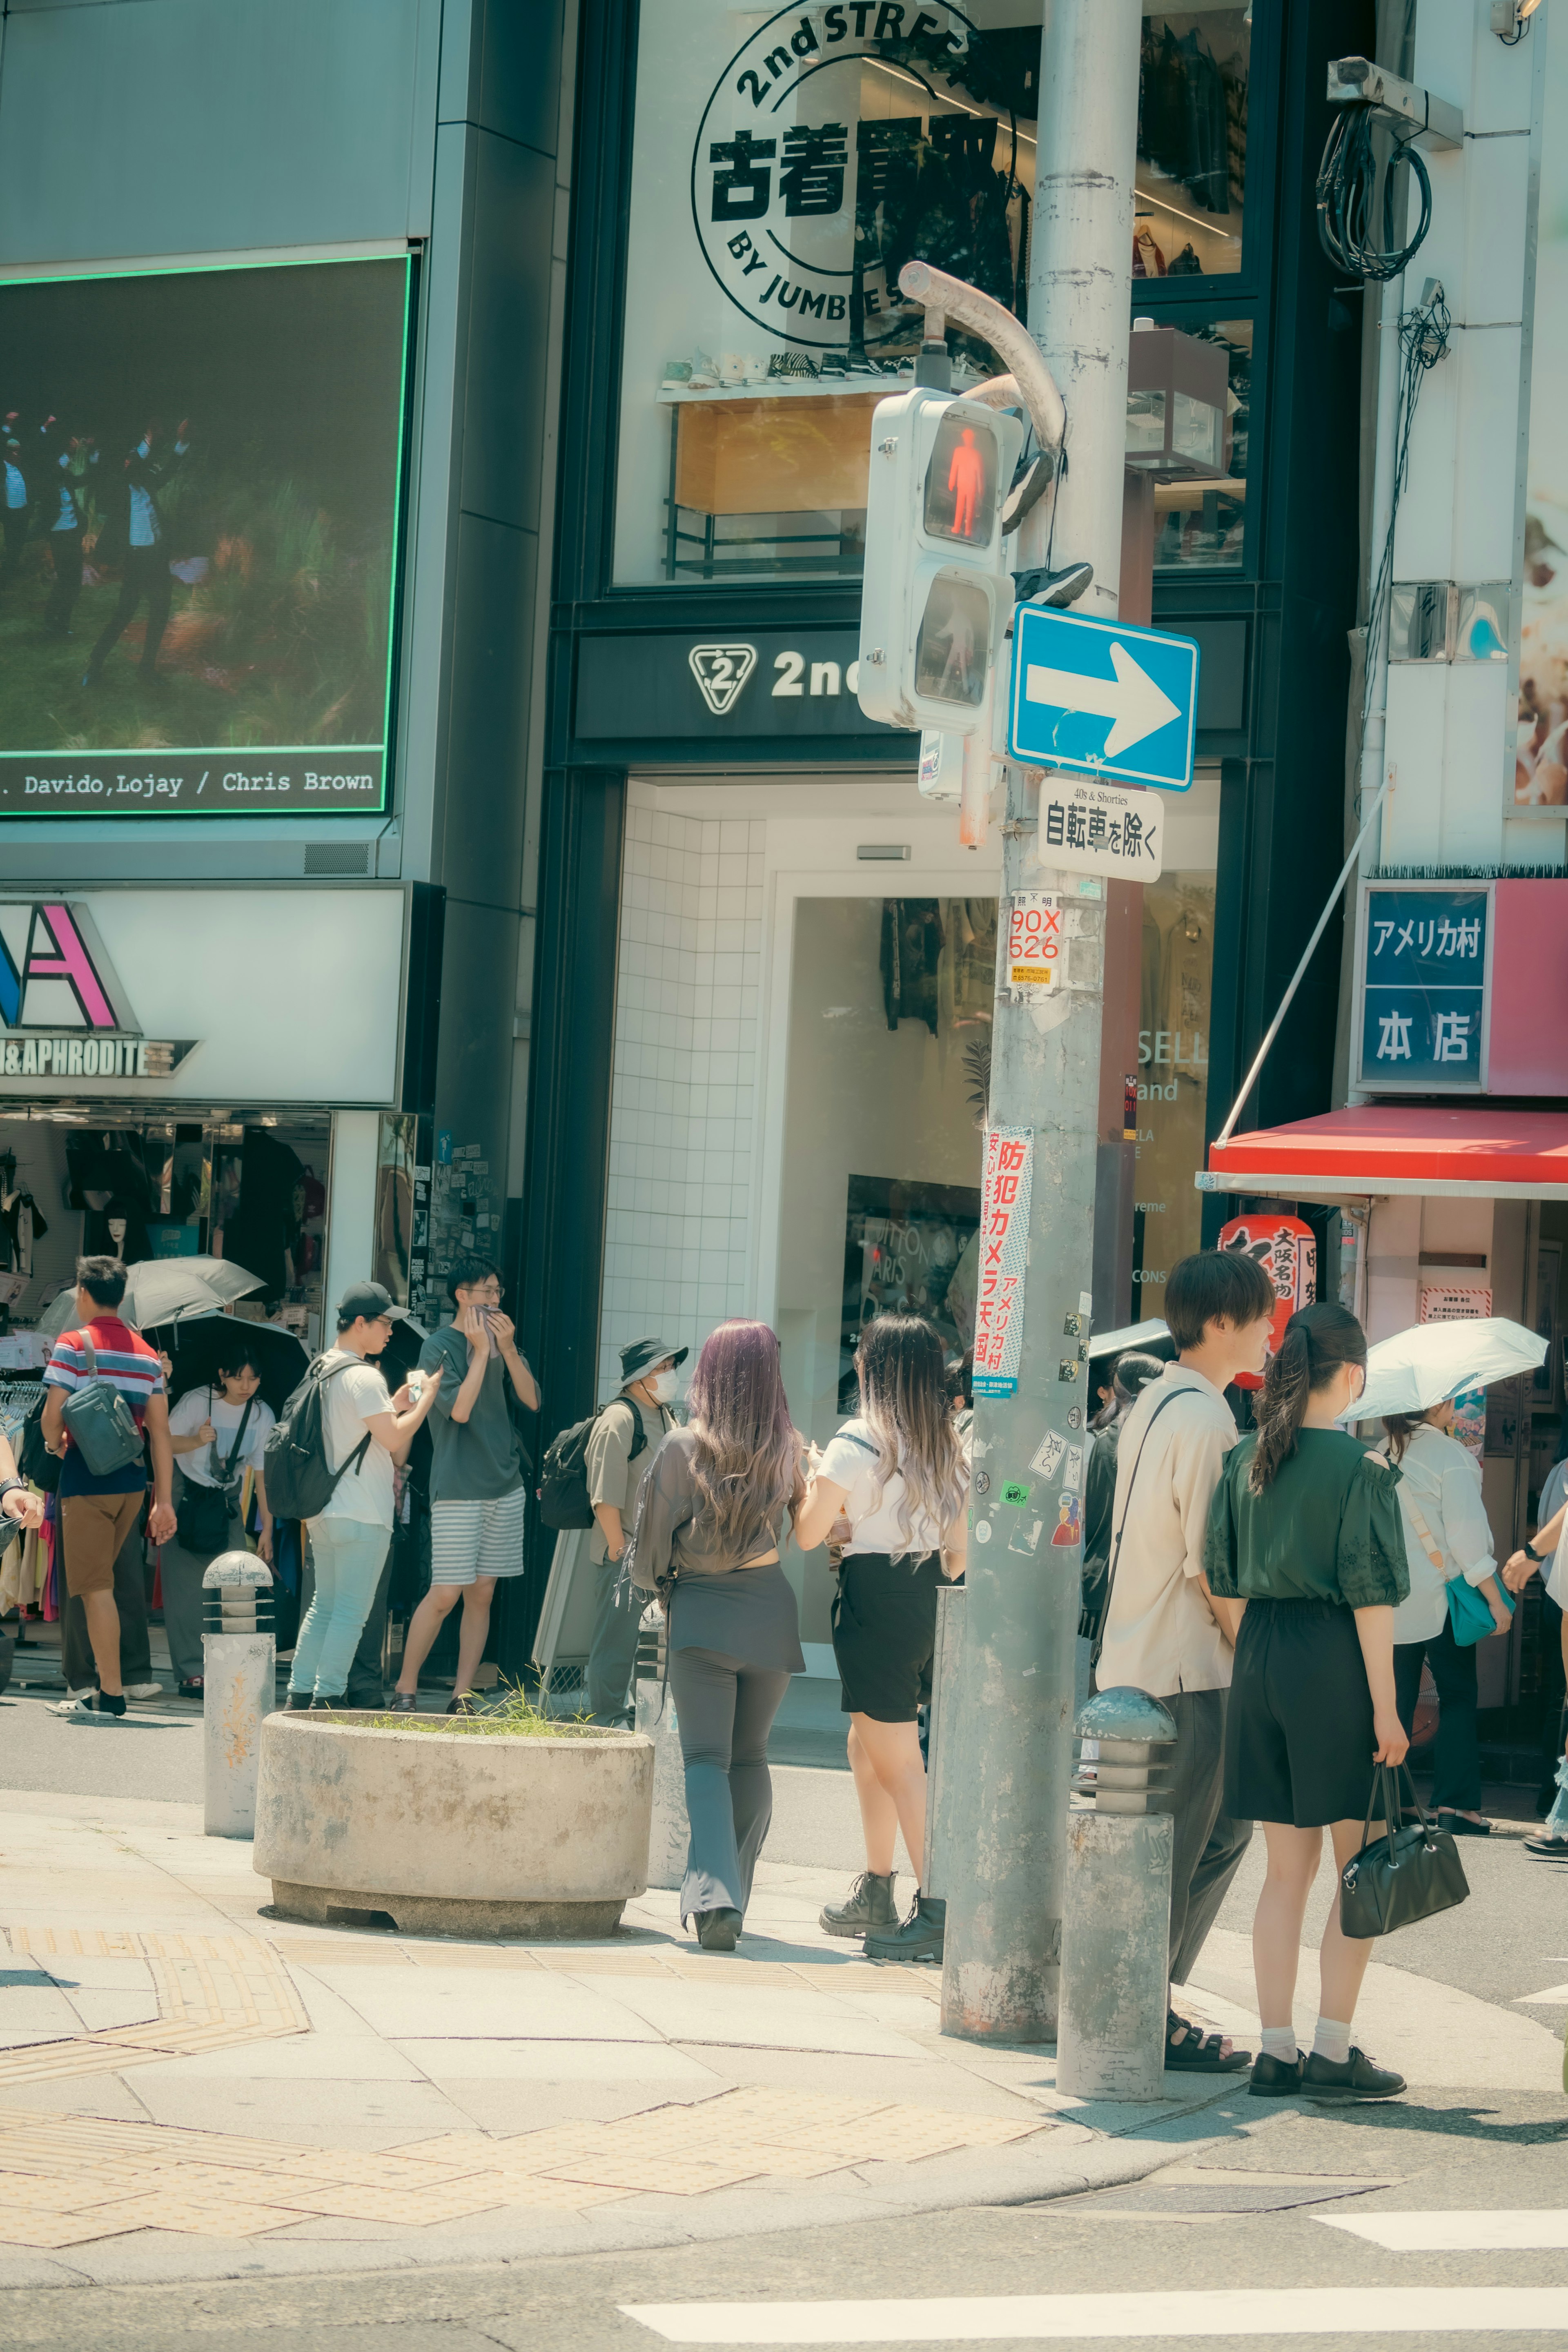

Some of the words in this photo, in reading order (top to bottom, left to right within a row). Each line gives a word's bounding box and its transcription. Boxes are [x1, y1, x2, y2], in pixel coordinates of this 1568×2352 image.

[727, 229, 768, 276] BY
[223, 772, 290, 791] Chris
[303, 772, 374, 791] Brown
[1074, 787, 1087, 800] 40s
[1089, 791, 1095, 800] &
[1098, 791, 1128, 806] Shorties
[1047, 800, 1156, 861] 自転車を除く
[1011, 909, 1060, 933] 90X
[1373, 917, 1481, 958] アメリカ村
[1009, 935, 1058, 959] 526
[0, 1038, 149, 1076] &APHRODITE
[1138, 1031, 1209, 1064] SELL
[1134, 1202, 1166, 1212] reme
[1131, 1270, 1167, 1283] CONS
[1272, 1228, 1296, 1298] 大阪名物
[987, 1277, 1018, 1370] アメリカ村
